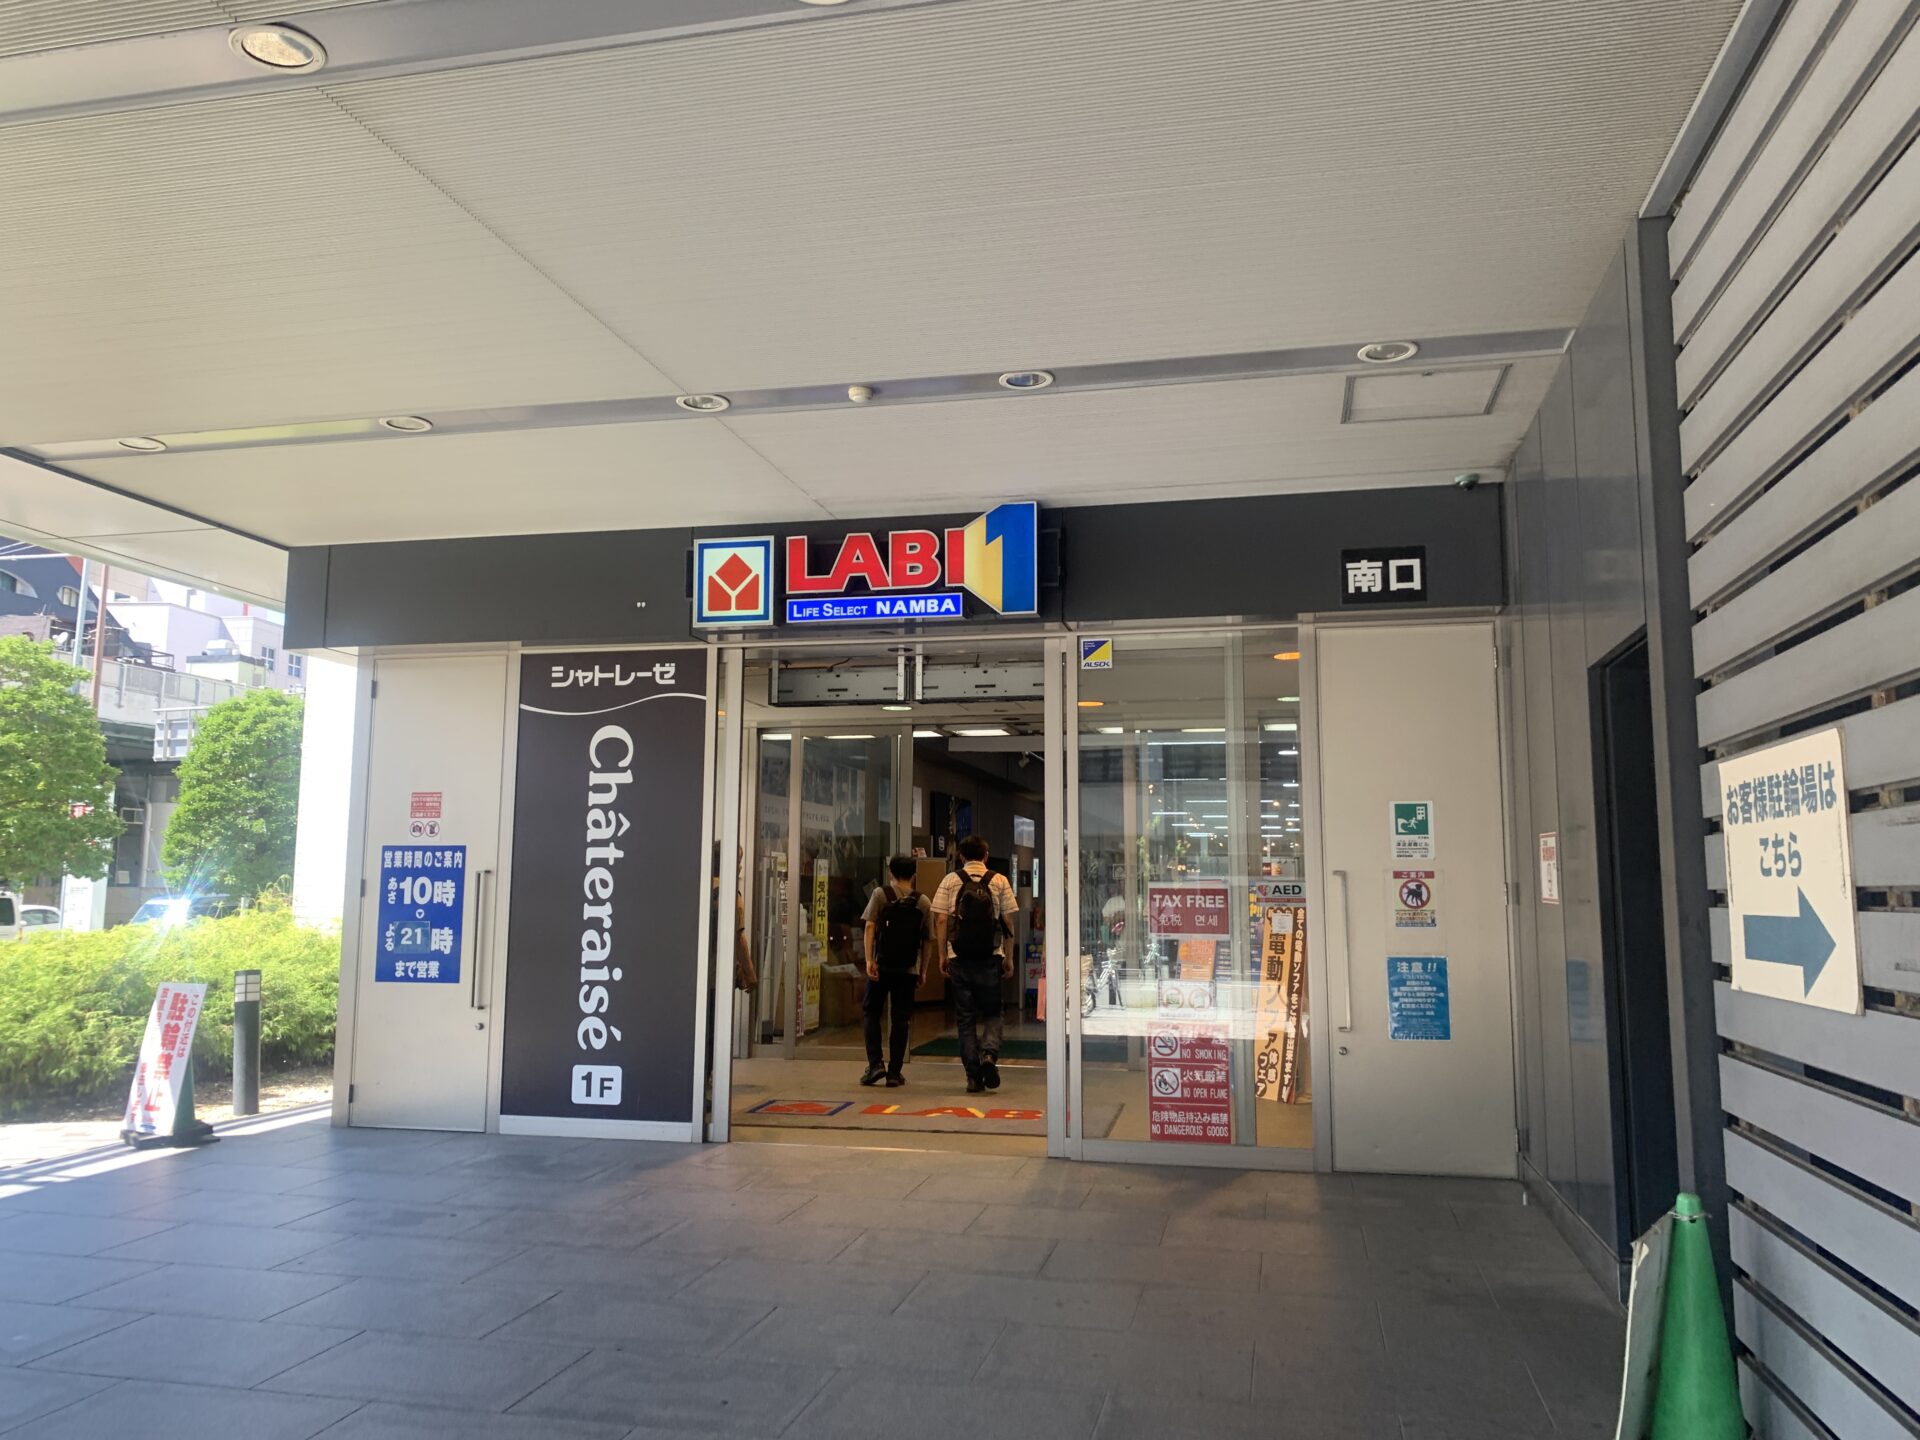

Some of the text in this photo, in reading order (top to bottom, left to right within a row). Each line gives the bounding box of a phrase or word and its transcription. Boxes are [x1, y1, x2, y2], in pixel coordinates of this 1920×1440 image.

[1346, 559, 1421, 593] 南口
[876, 598, 957, 615] NAMBA
[551, 663, 676, 688] シャトレーゼ
[1726, 761, 1837, 826] お客様駐輪場は
[383, 850, 463, 868] 営業時間のご案内
[1759, 831, 1802, 878] こちら
[387, 876, 456, 907] あさ 10時
[1272, 884, 1302, 895] AED
[1152, 894, 1225, 908] TAX FREE
[1195, 914, 1218, 926] 면세
[385, 923, 395, 951] よる
[395, 960, 440, 978] まで営業
[1181, 1048, 1227, 1060] NO SMOKING
[580, 1071, 615, 1099] 1F
[1182, 1070, 1227, 1083] 火気厳禁
[1182, 1088, 1228, 1099] NO OPEN FLAME
[1152, 1111, 1229, 1125] 危険物品持込み厳禁
[1152, 1124, 1229, 1137] NO DANGEROUS GOODS
